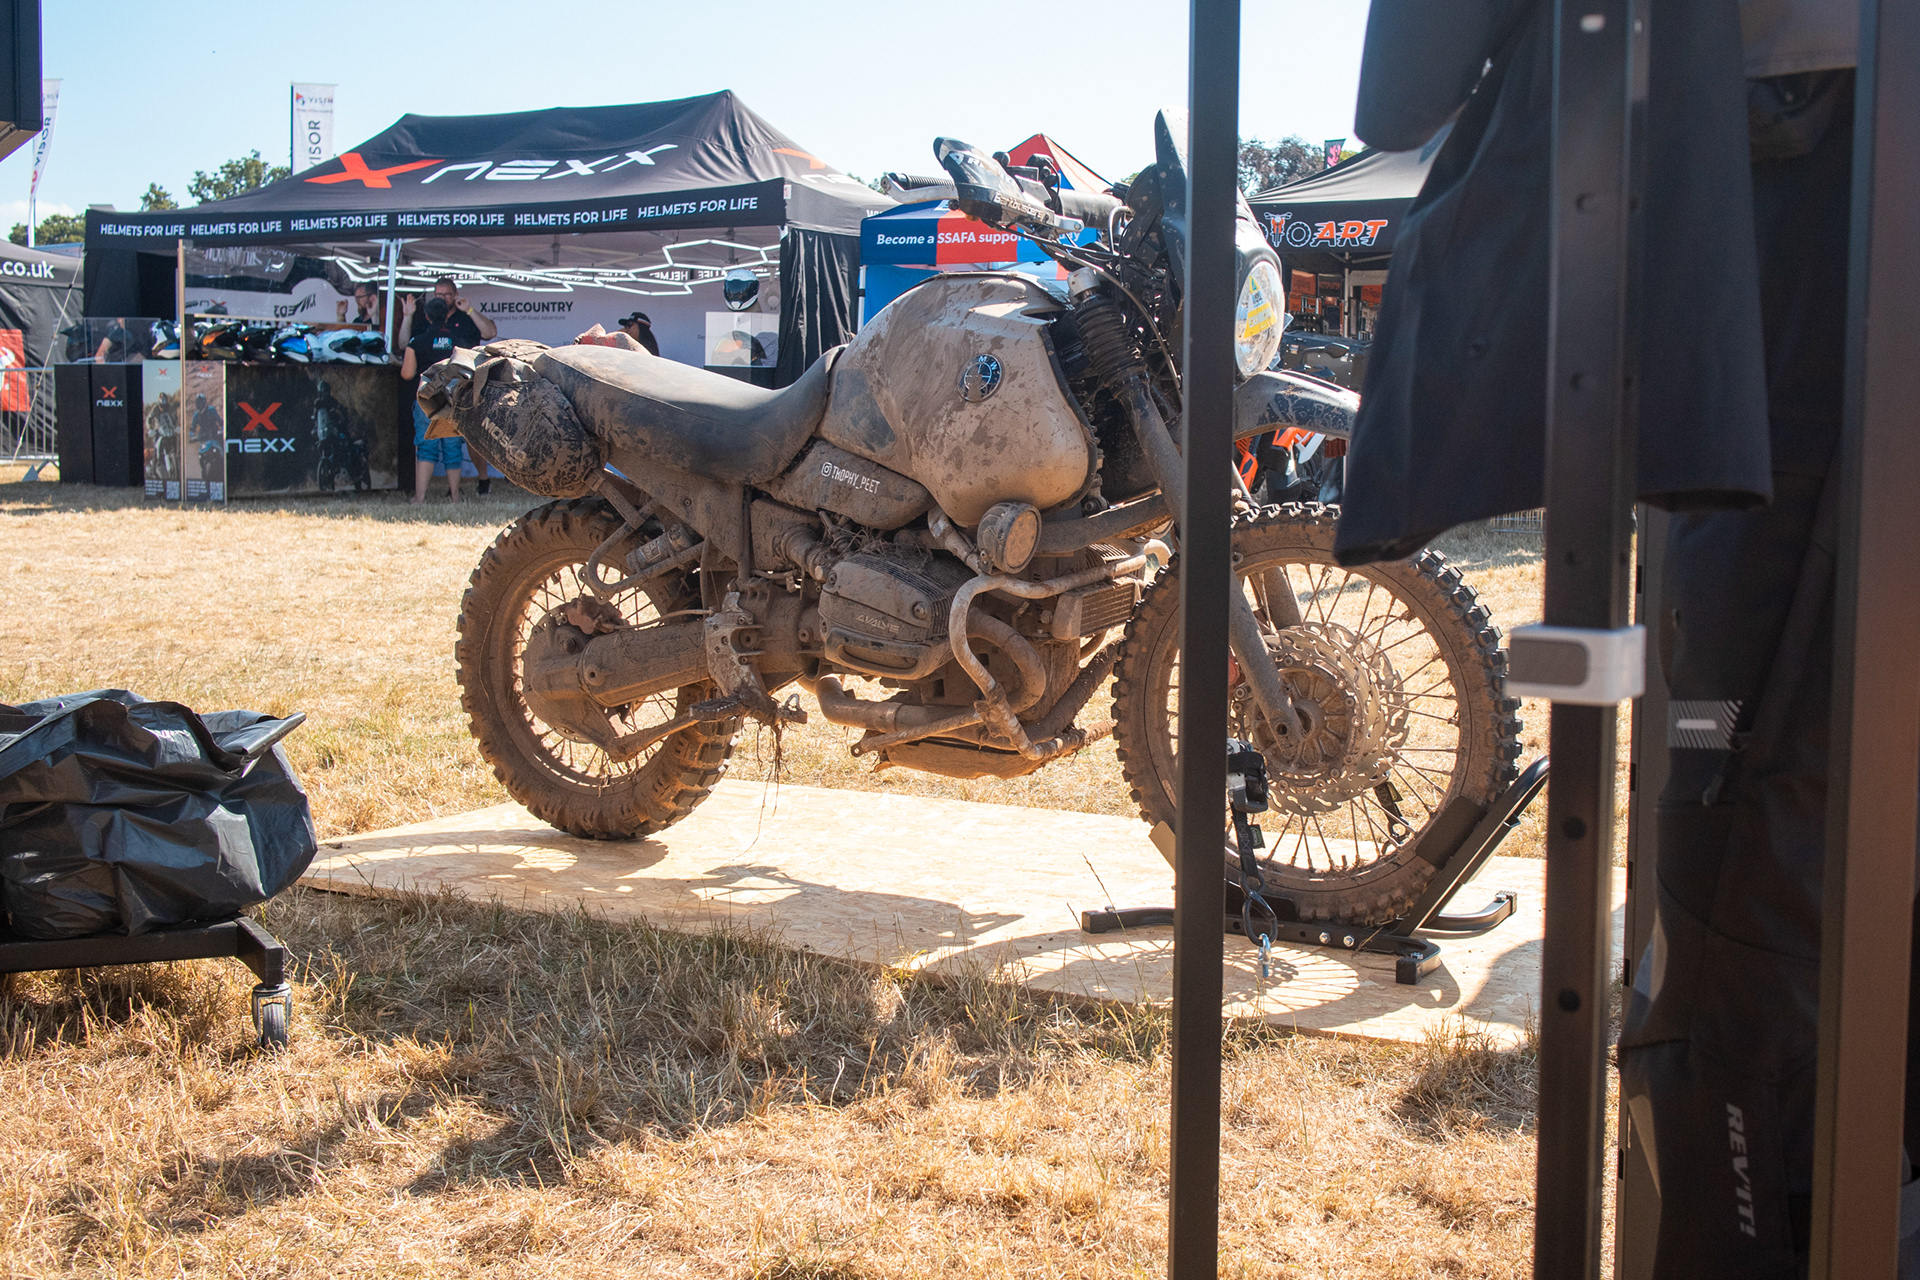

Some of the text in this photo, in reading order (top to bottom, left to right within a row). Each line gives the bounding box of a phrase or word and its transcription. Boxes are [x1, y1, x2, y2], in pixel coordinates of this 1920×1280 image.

[33, 116, 52, 168] VISOR
[637, 196, 758, 218] HELMETS FOR LIFE
[291, 214, 387, 231] HELMETS FOR LIFE
[398, 213, 505, 226] HELMETS FOR LIFE
[514, 208, 628, 226] HELMETS FOR LIFE
[101, 224, 185, 236] HELMETS FOR LIFE
[191, 220, 282, 235] HELMETS FOR LIFE
[876, 233, 925, 245] Become
[927, 235, 935, 244] a
[937, 231, 976, 244] SSAFA
[480, 301, 574, 313] X.LIFECOUNTRY
[481, 416, 528, 464] MOSKO
[1725, 1102, 1757, 1237] REV'IT!
